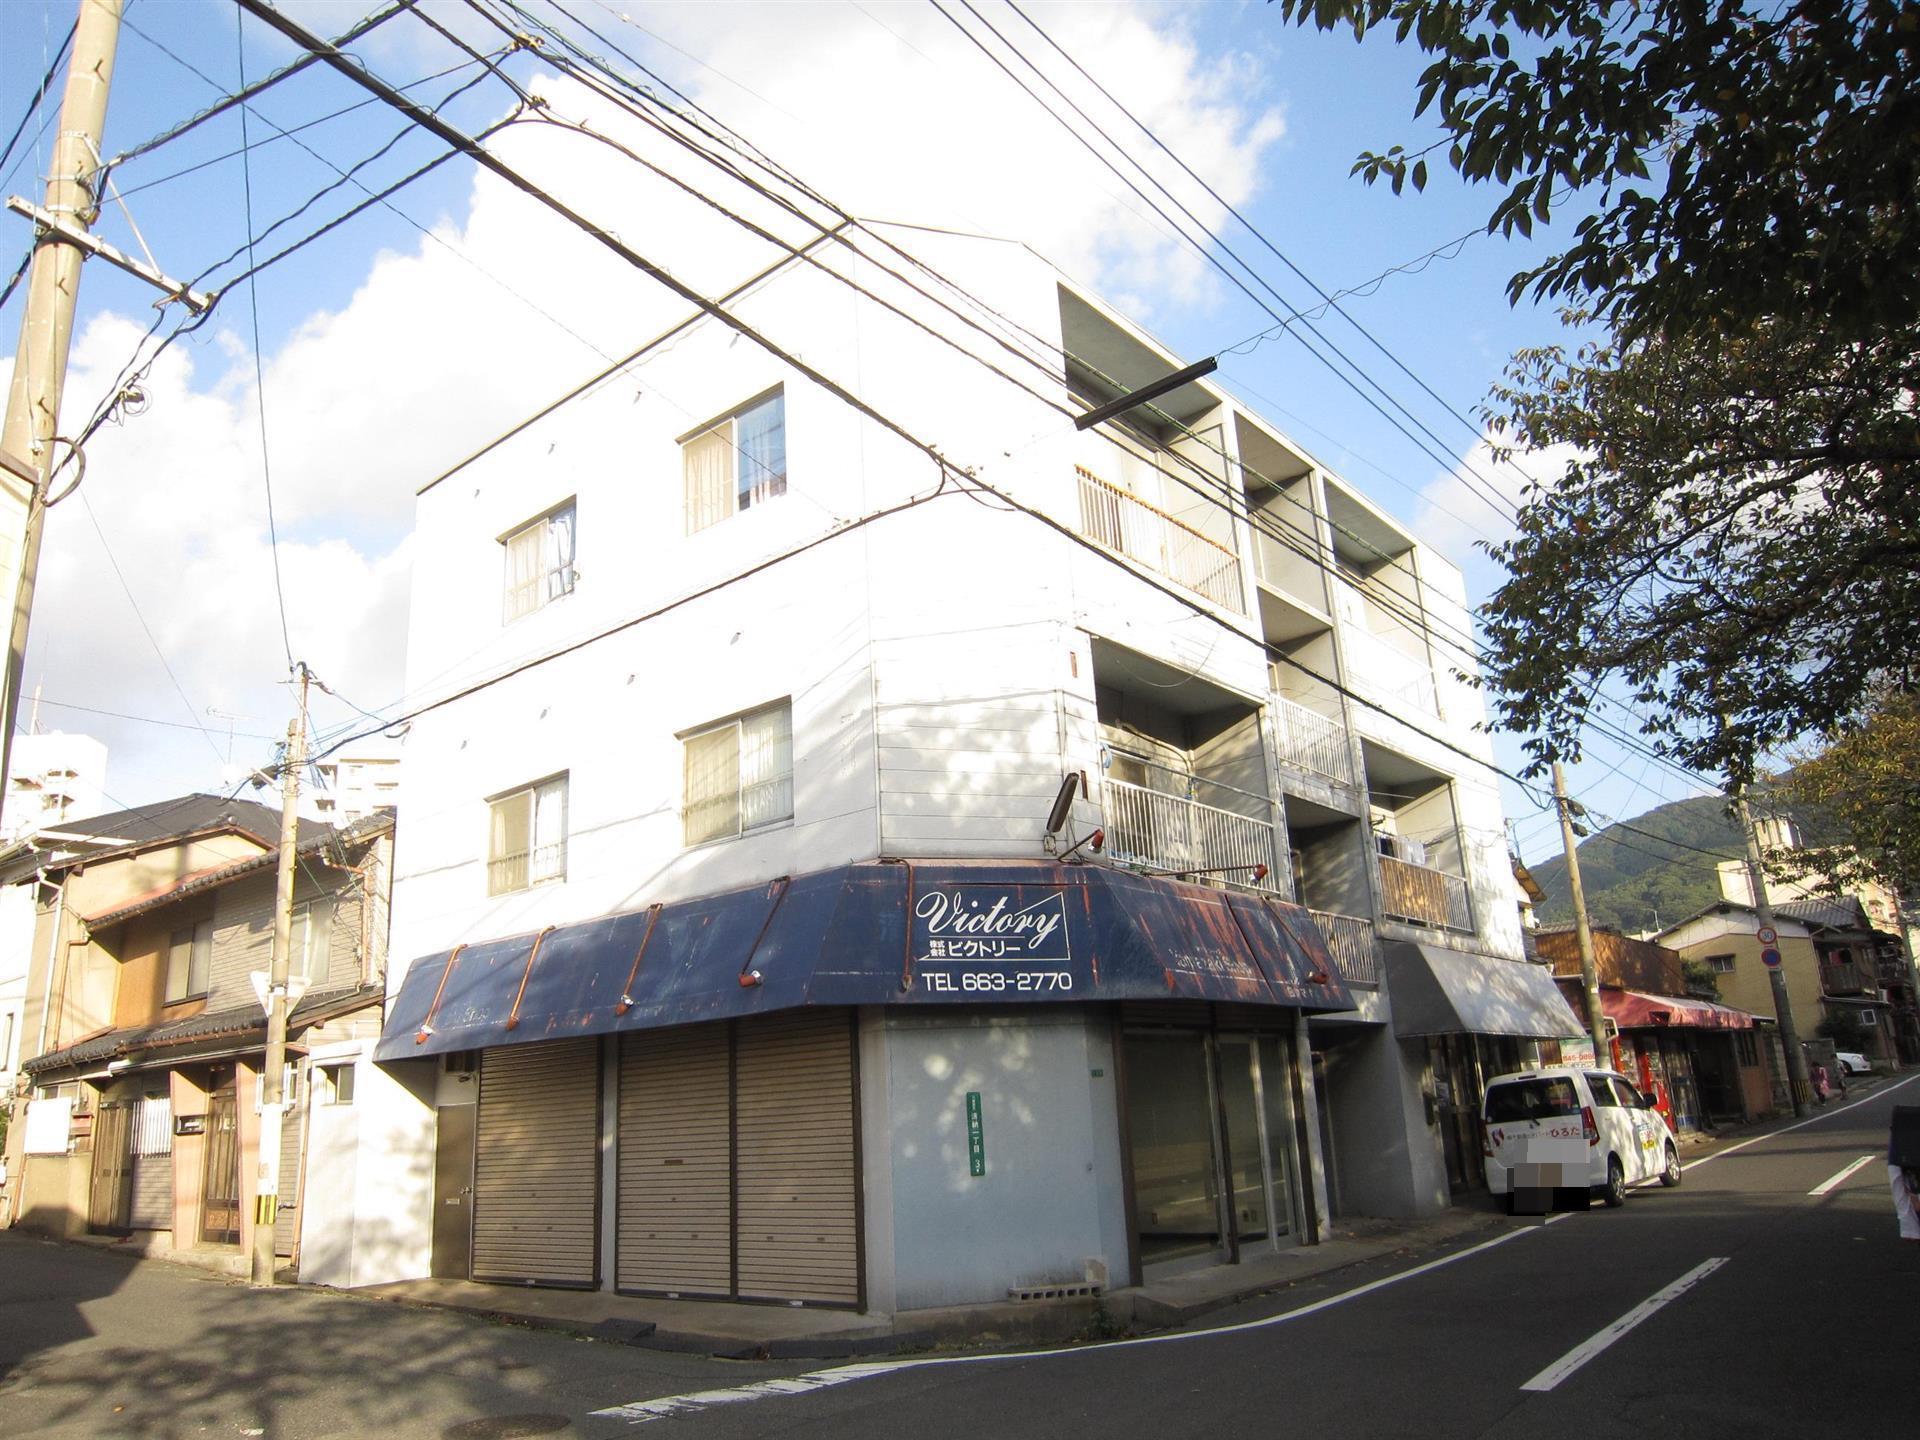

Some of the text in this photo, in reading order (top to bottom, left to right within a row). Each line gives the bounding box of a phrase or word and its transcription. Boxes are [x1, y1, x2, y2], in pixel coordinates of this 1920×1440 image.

[916, 891, 1061, 949] Victory
[922, 972, 1073, 991] TEL 663-2770
